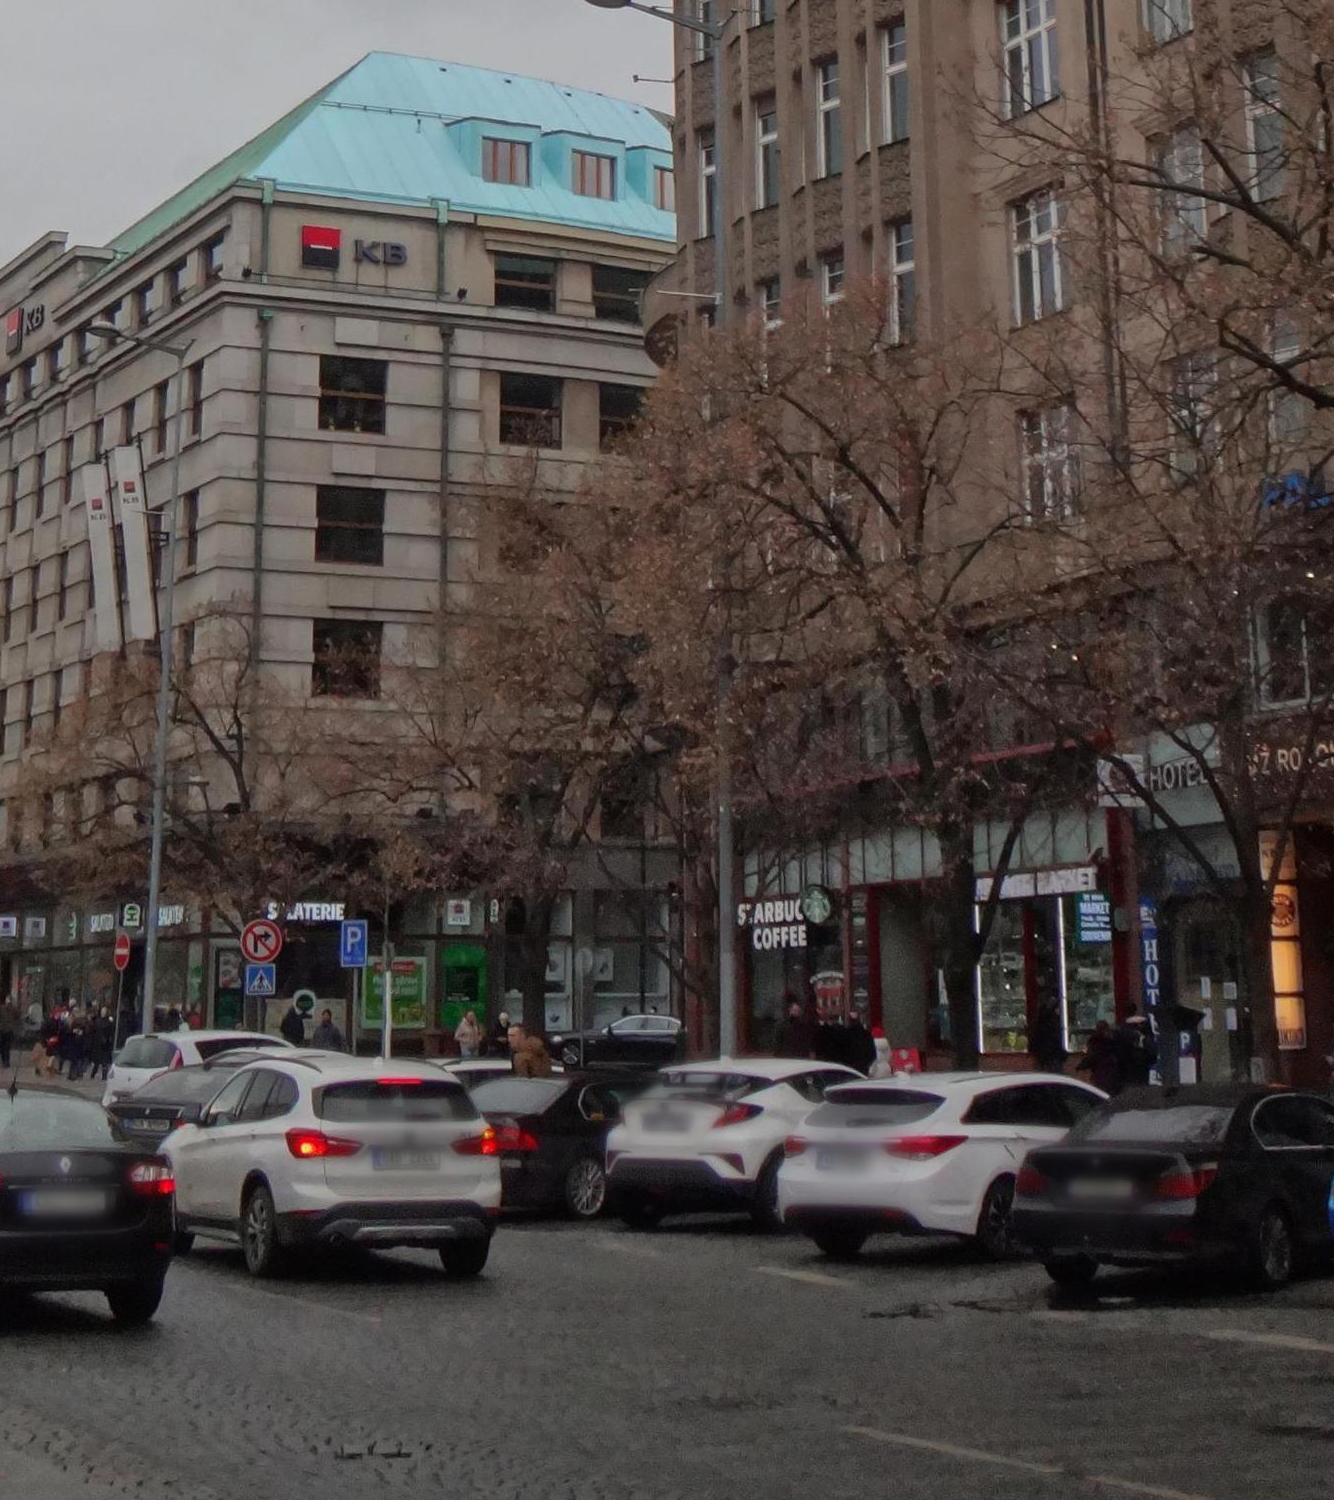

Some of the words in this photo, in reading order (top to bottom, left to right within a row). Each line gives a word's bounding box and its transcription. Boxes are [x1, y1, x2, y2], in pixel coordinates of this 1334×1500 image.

[354, 238, 408, 267] KB
[23, 303, 45, 336] KB
[1149, 757, 1210, 792] HOTEL
[267, 902, 346, 921] SLATERIE
[737, 898, 805, 926] SARBUC
[347, 926, 362, 954] P
[753, 925, 808, 950] COFFEE
